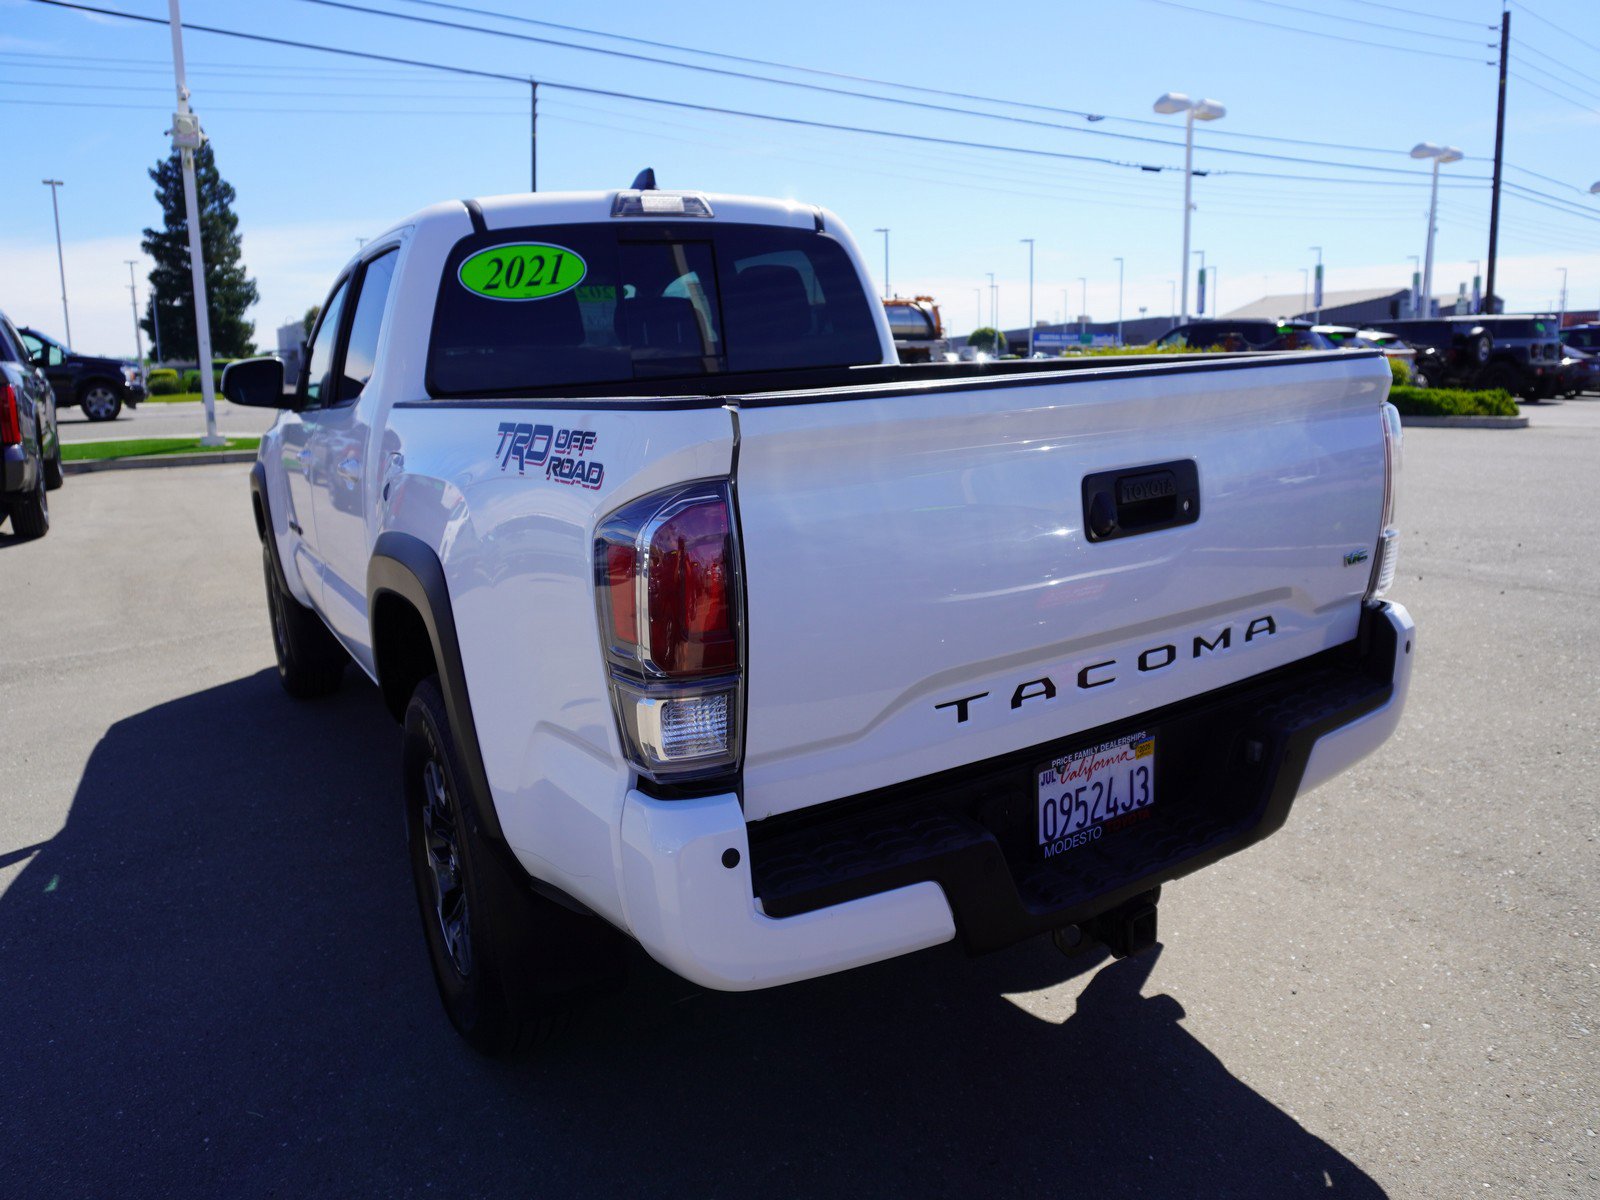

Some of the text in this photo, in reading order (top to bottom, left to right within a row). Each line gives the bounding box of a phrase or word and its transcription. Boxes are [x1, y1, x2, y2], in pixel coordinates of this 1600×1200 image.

[483, 252, 564, 291] 2021
[496, 422, 554, 475] TRD
[555, 429, 597, 456] OFF
[545, 455, 605, 490] ROAD
[1124, 477, 1175, 501] TOYOTA
[935, 615, 1276, 723] TACOMA
[1051, 731, 1147, 768] PRICE FAMILY DEALERSHIPS
[1041, 769, 1056, 786] JUL
[1060, 751, 1136, 785] California
[1043, 765, 1149, 842] 09524J3
[1044, 826, 1103, 859] MODESTO
